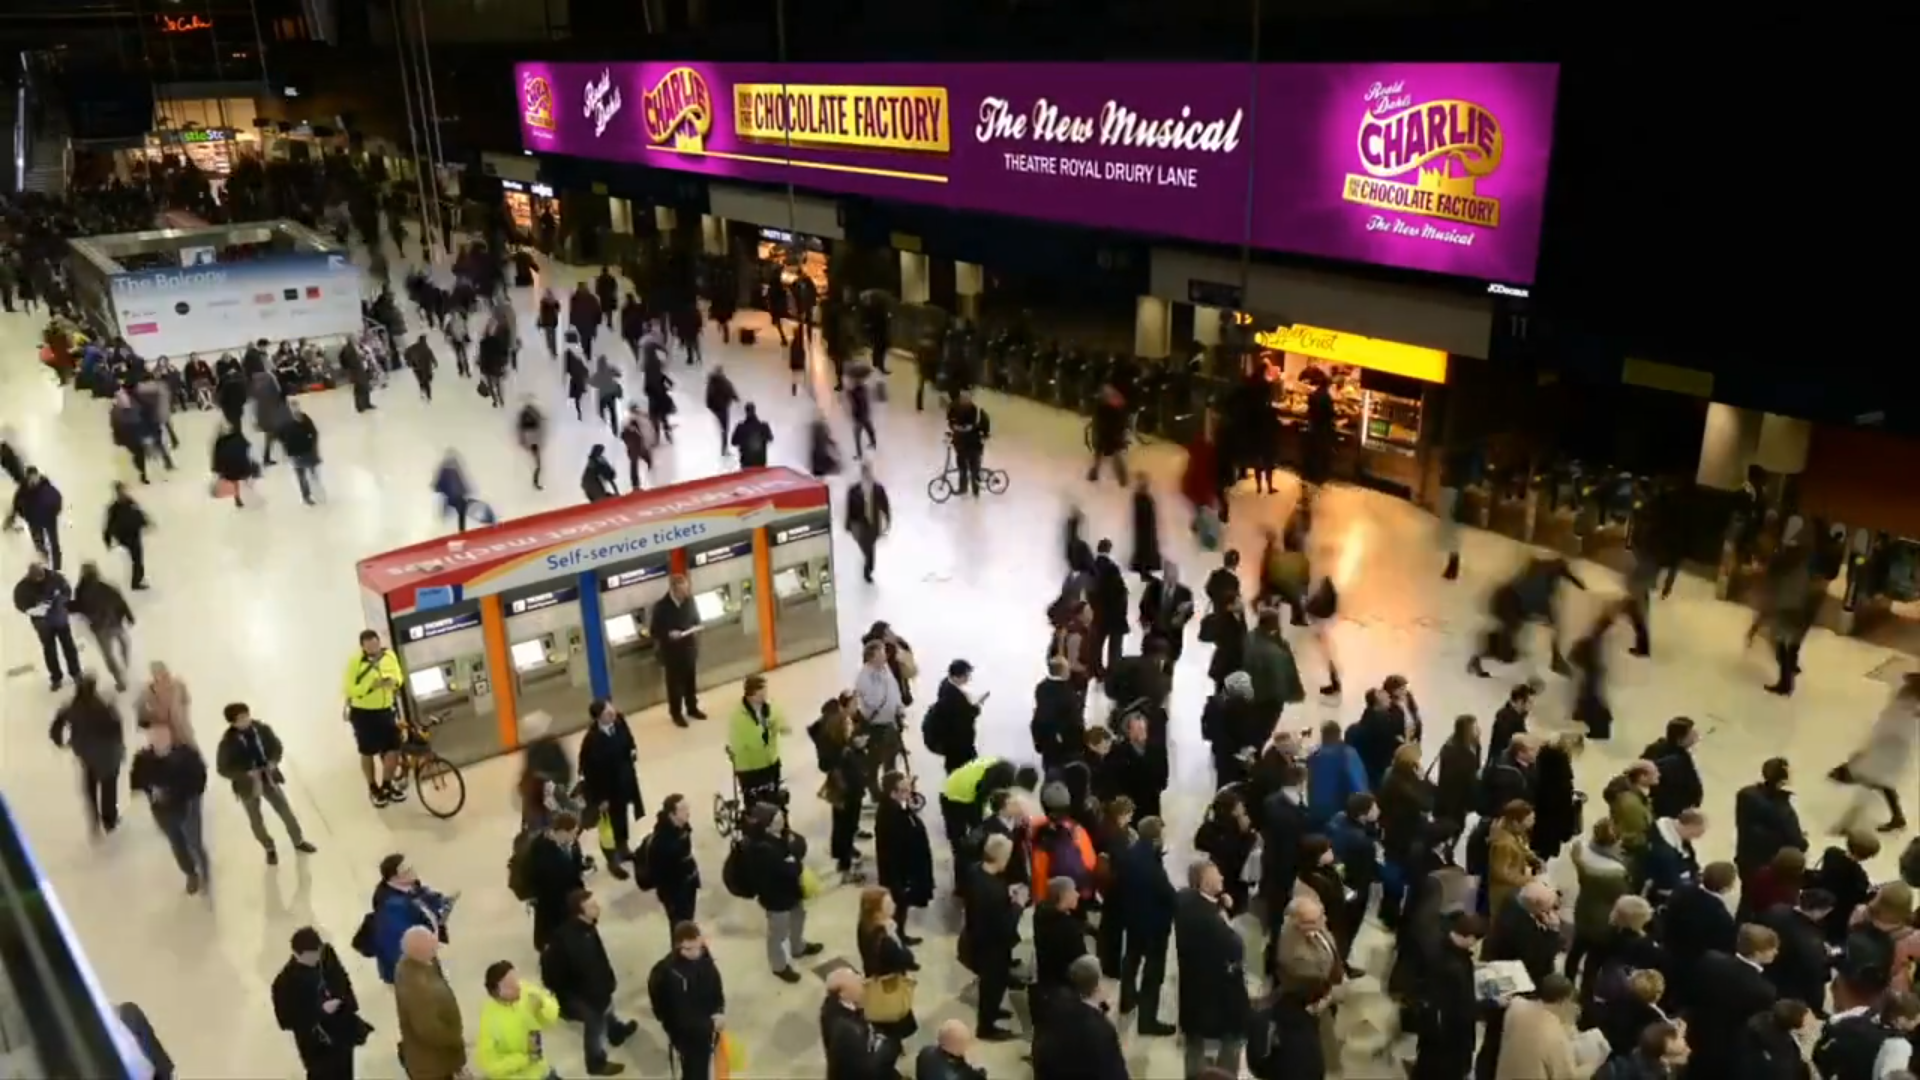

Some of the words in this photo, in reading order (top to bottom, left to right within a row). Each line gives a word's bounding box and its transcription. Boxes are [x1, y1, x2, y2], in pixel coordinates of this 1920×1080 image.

[645, 69, 708, 136] CHARLIE
[1364, 80, 1404, 101] Roald
[754, 92, 849, 135] CHOCOLATE
[855, 95, 941, 142] FACTORY
[976, 96, 1027, 143] The
[1032, 98, 1094, 144] New
[1100, 100, 1244, 153] Musical
[1360, 104, 1497, 168] CHARLIE
[1004, 153, 1057, 175] THEATRE
[1060, 158, 1102, 179] ROYAL
[1105, 162, 1154, 184] DRURY
[1157, 166, 1198, 188] LANE
[1361, 180, 1433, 211] CHOCOLATE
[1436, 192, 1496, 222] FACTORY
[1366, 215, 1391, 231] The
[1392, 219, 1419, 236] New
[1421, 224, 1475, 246] Musical
[545, 537, 648, 572] Self-service
[653, 522, 707, 546] tickets
